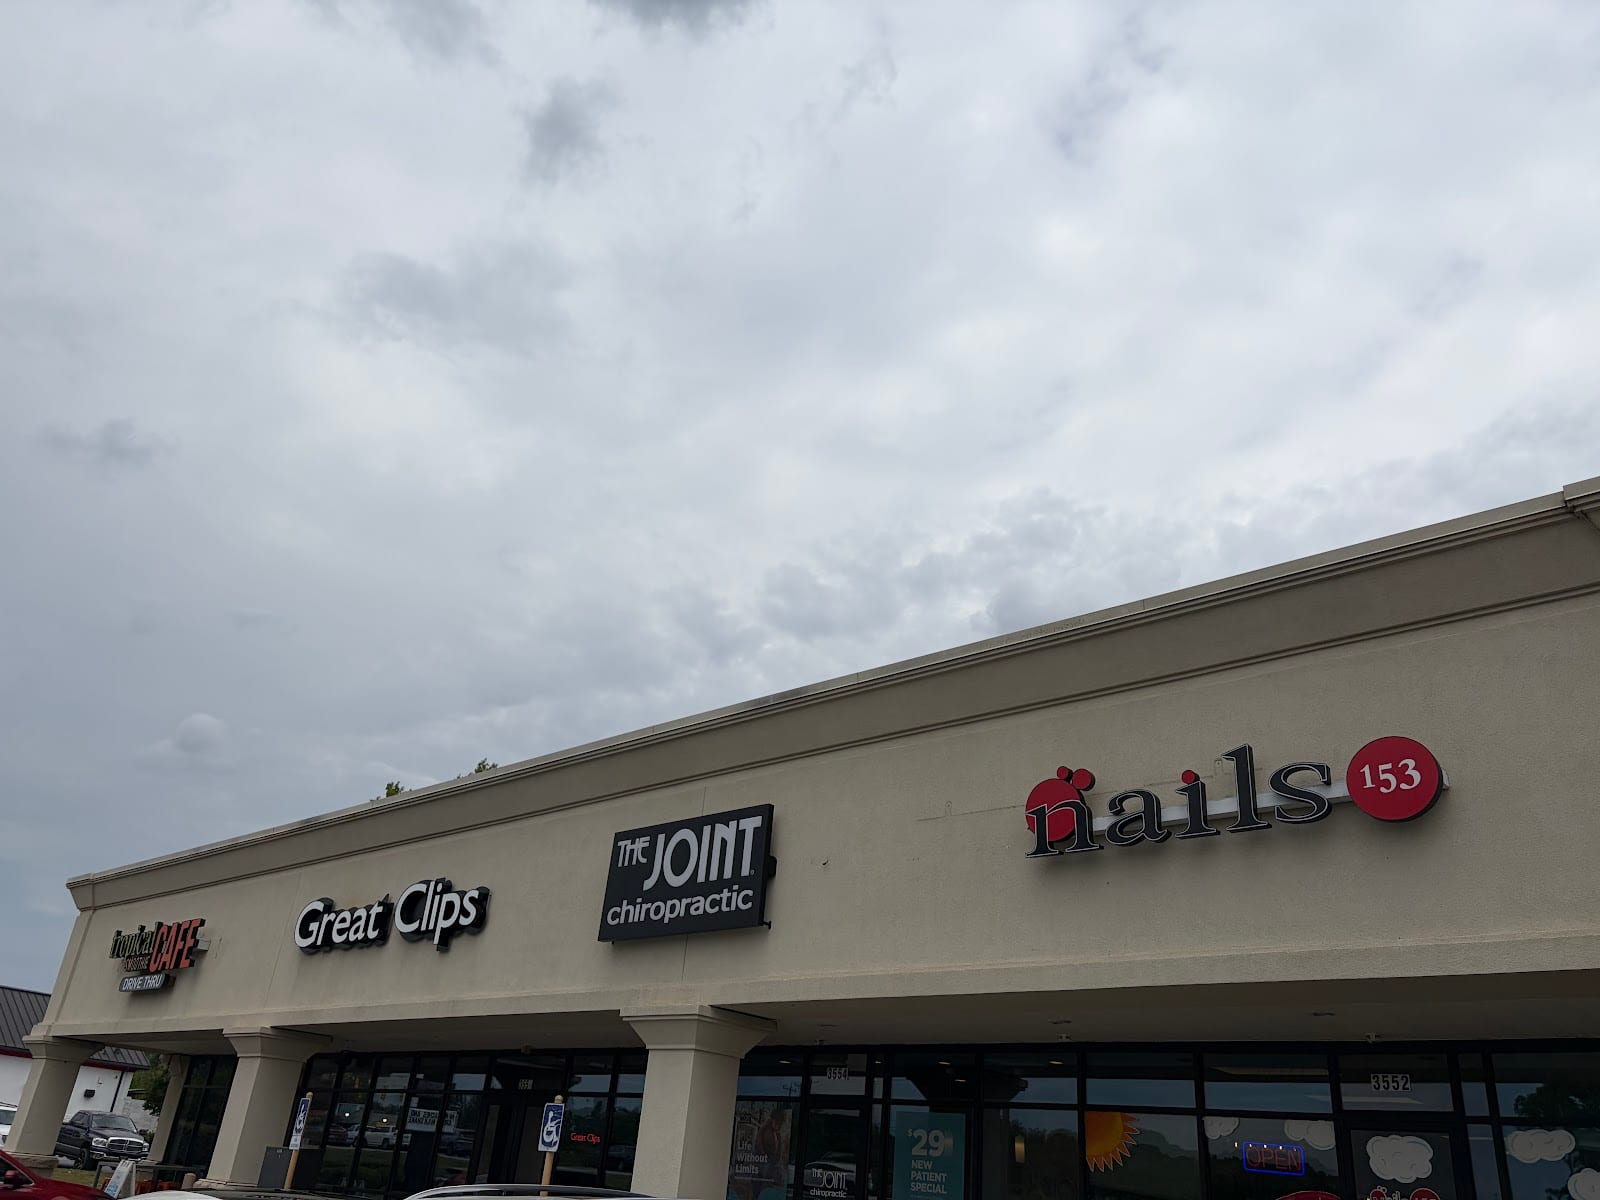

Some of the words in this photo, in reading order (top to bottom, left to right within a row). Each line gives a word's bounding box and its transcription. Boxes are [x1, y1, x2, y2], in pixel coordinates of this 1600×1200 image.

[1359, 758, 1422, 794] 153
[1026, 743, 1332, 858] nails
[617, 835, 650, 868] THE
[642, 815, 763, 892] JOINT
[606, 884, 754, 925] chiropractic
[294, 900, 384, 949] Great
[394, 880, 480, 946] Clips
[149, 918, 203, 973] CAFE
[122, 977, 143, 991] DRIVE
[143, 974, 163, 988] THRU
[1371, 1074, 1410, 1091] 3552
[736, 1141, 752, 1151] Life
[735, 1151, 768, 1163] Without
[911, 1159, 933, 1170] NEW
[1245, 1146, 1302, 1172] OPEN
[735, 1163, 760, 1175] Limits
[910, 1170, 948, 1183] PATIENT
[819, 1169, 847, 1190] JOINT
[910, 1181, 948, 1194] SPECIAL
[809, 1187, 848, 1199] chiropractic
